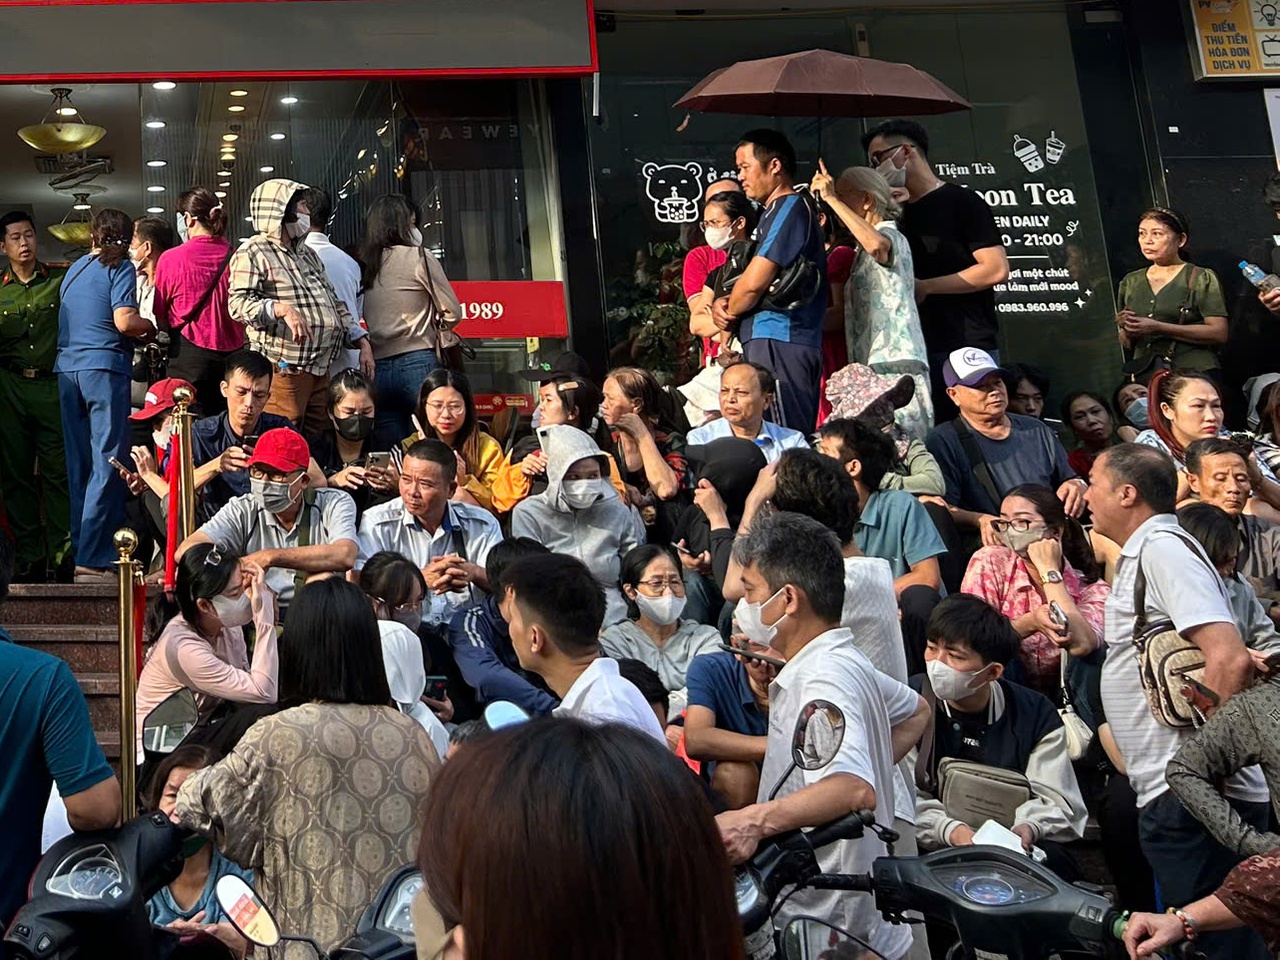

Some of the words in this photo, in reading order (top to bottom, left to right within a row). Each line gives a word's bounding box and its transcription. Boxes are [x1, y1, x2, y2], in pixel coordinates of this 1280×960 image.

[1205, 35, 1224, 45] THU
[1208, 47, 1229, 58] HÓA
[935, 162, 971, 178] Tiệm
[971, 162, 997, 176] Trà
[1023, 182, 1077, 207] Tea
[1012, 215, 1050, 228] DAILY
[1024, 233, 1064, 247] 21:00
[1045, 267, 1070, 278] chút
[1050, 281, 1080, 291] mood
[998, 302, 1070, 313] 0983.960.996
